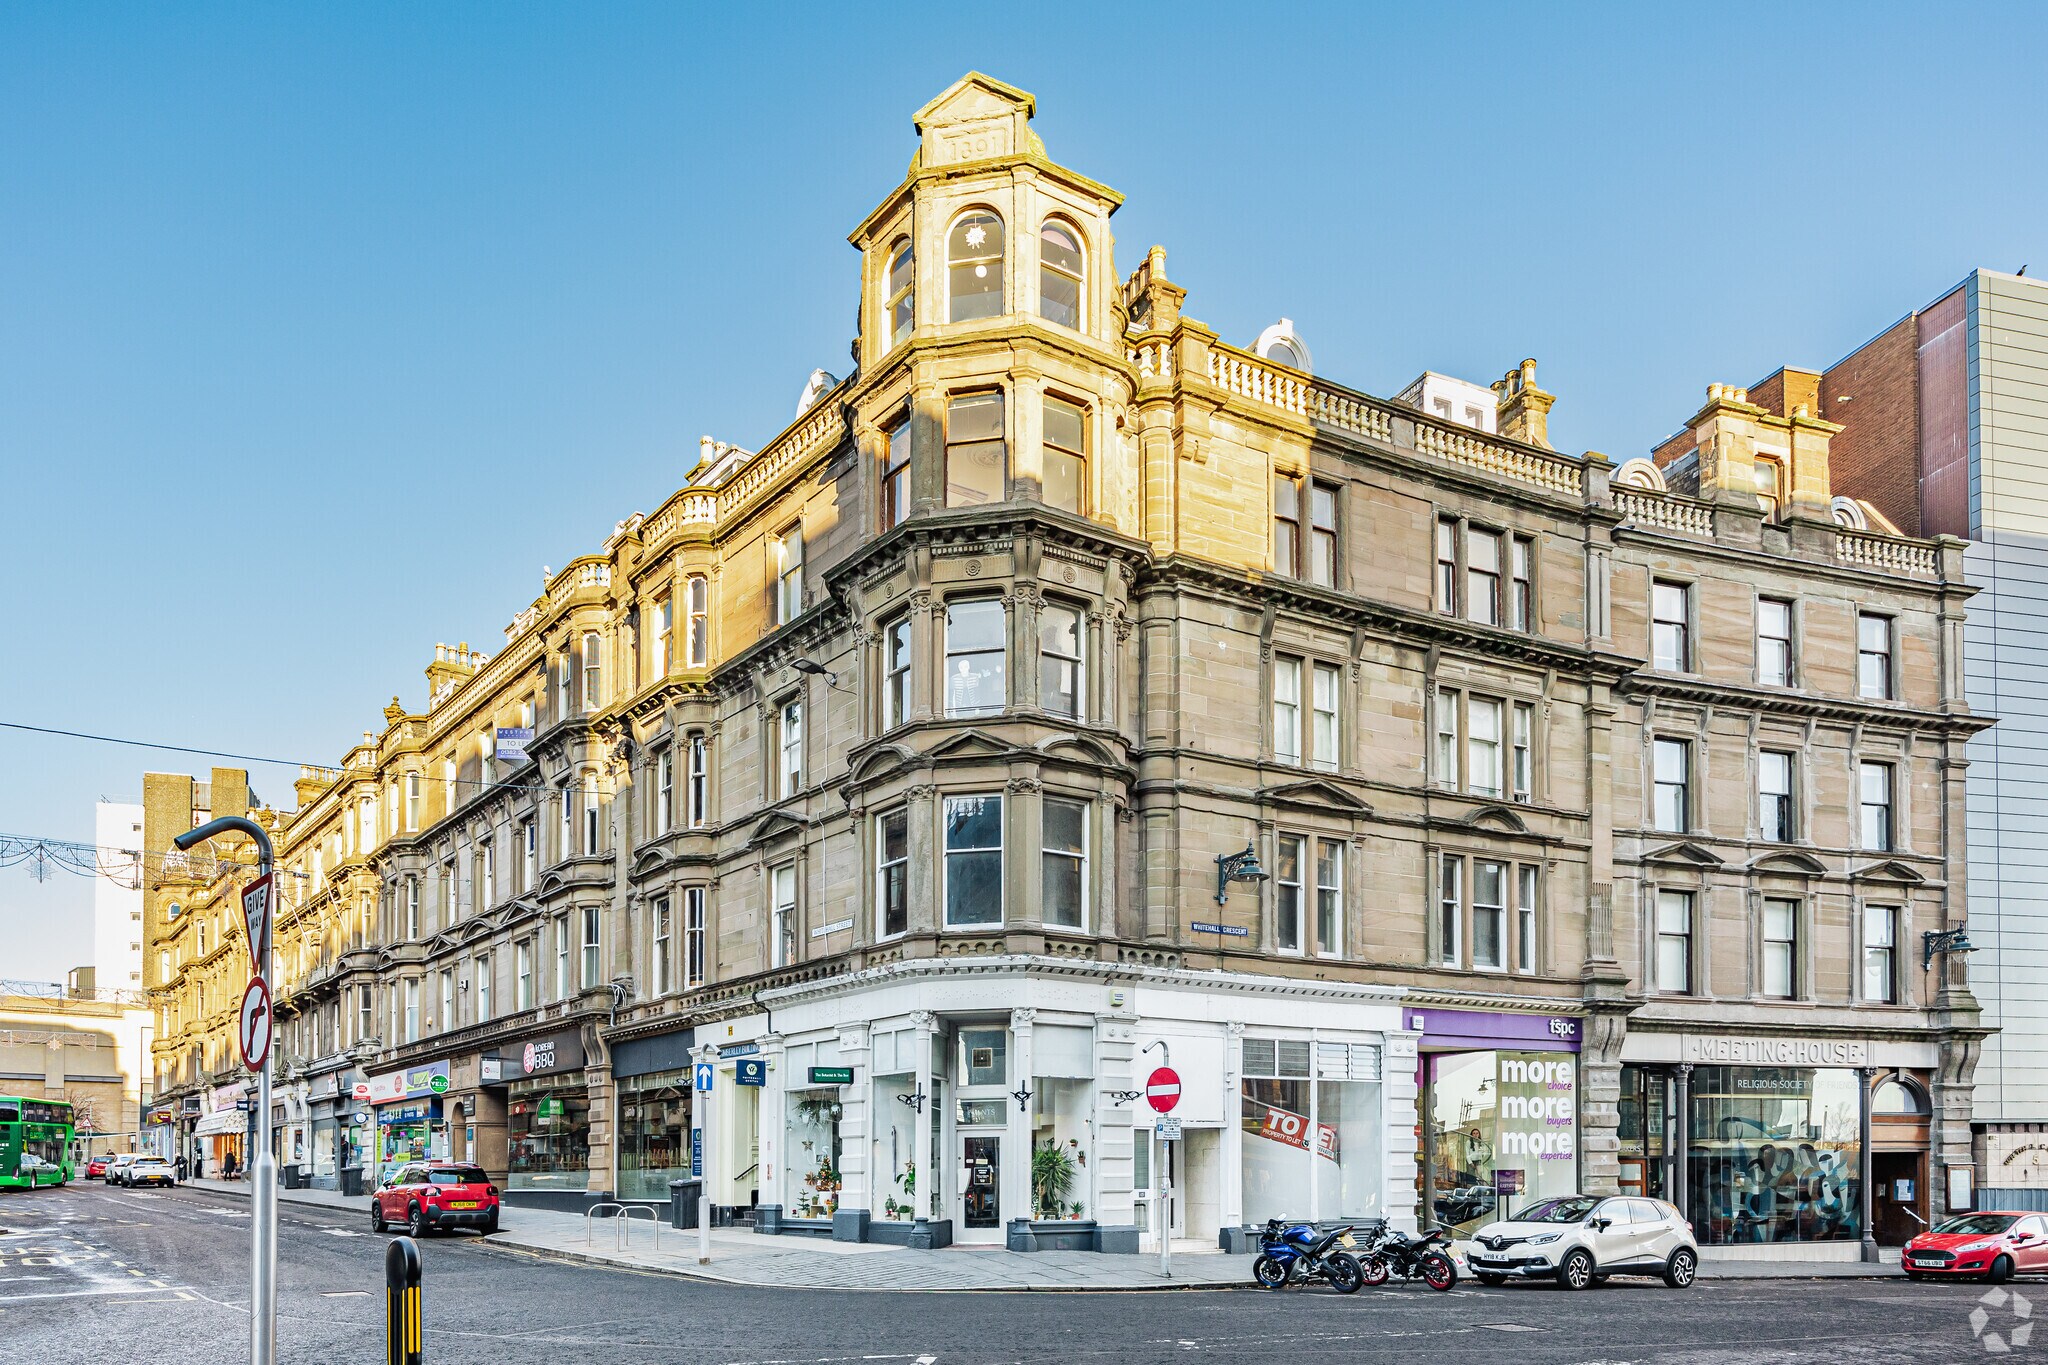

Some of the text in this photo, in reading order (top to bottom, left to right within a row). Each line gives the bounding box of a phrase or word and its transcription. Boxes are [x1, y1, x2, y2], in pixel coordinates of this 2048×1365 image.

[951, 135, 998, 161] 1891
[247, 889, 264, 931] GIVE WAY
[1193, 923, 1247, 935] WHITEHALL CRESCENT
[1550, 1019, 1575, 1037] tspc
[535, 1041, 555, 1052] KOREAN
[1700, 1038, 1859, 1064] MEETING HOUSE
[535, 1051, 555, 1069] BBQ
[1501, 1060, 1572, 1083] more
[1547, 1080, 1572, 1090] choice
[1737, 1079, 1777, 1089] RELIGIOUS
[1779, 1079, 1812, 1089] SOCIETY
[1501, 1096, 1573, 1119] more
[1268, 1109, 1300, 1136] TO
[1546, 1115, 1572, 1128] buyers
[1262, 1128, 1286, 1140] PROPERTY
[1286, 1135, 1293, 1143] TO
[1502, 1132, 1573, 1154] more
[1540, 1151, 1573, 1162] expertise
[2032, 1154, 2039, 1165] 5
[1456, 1257, 1463, 1265] L
